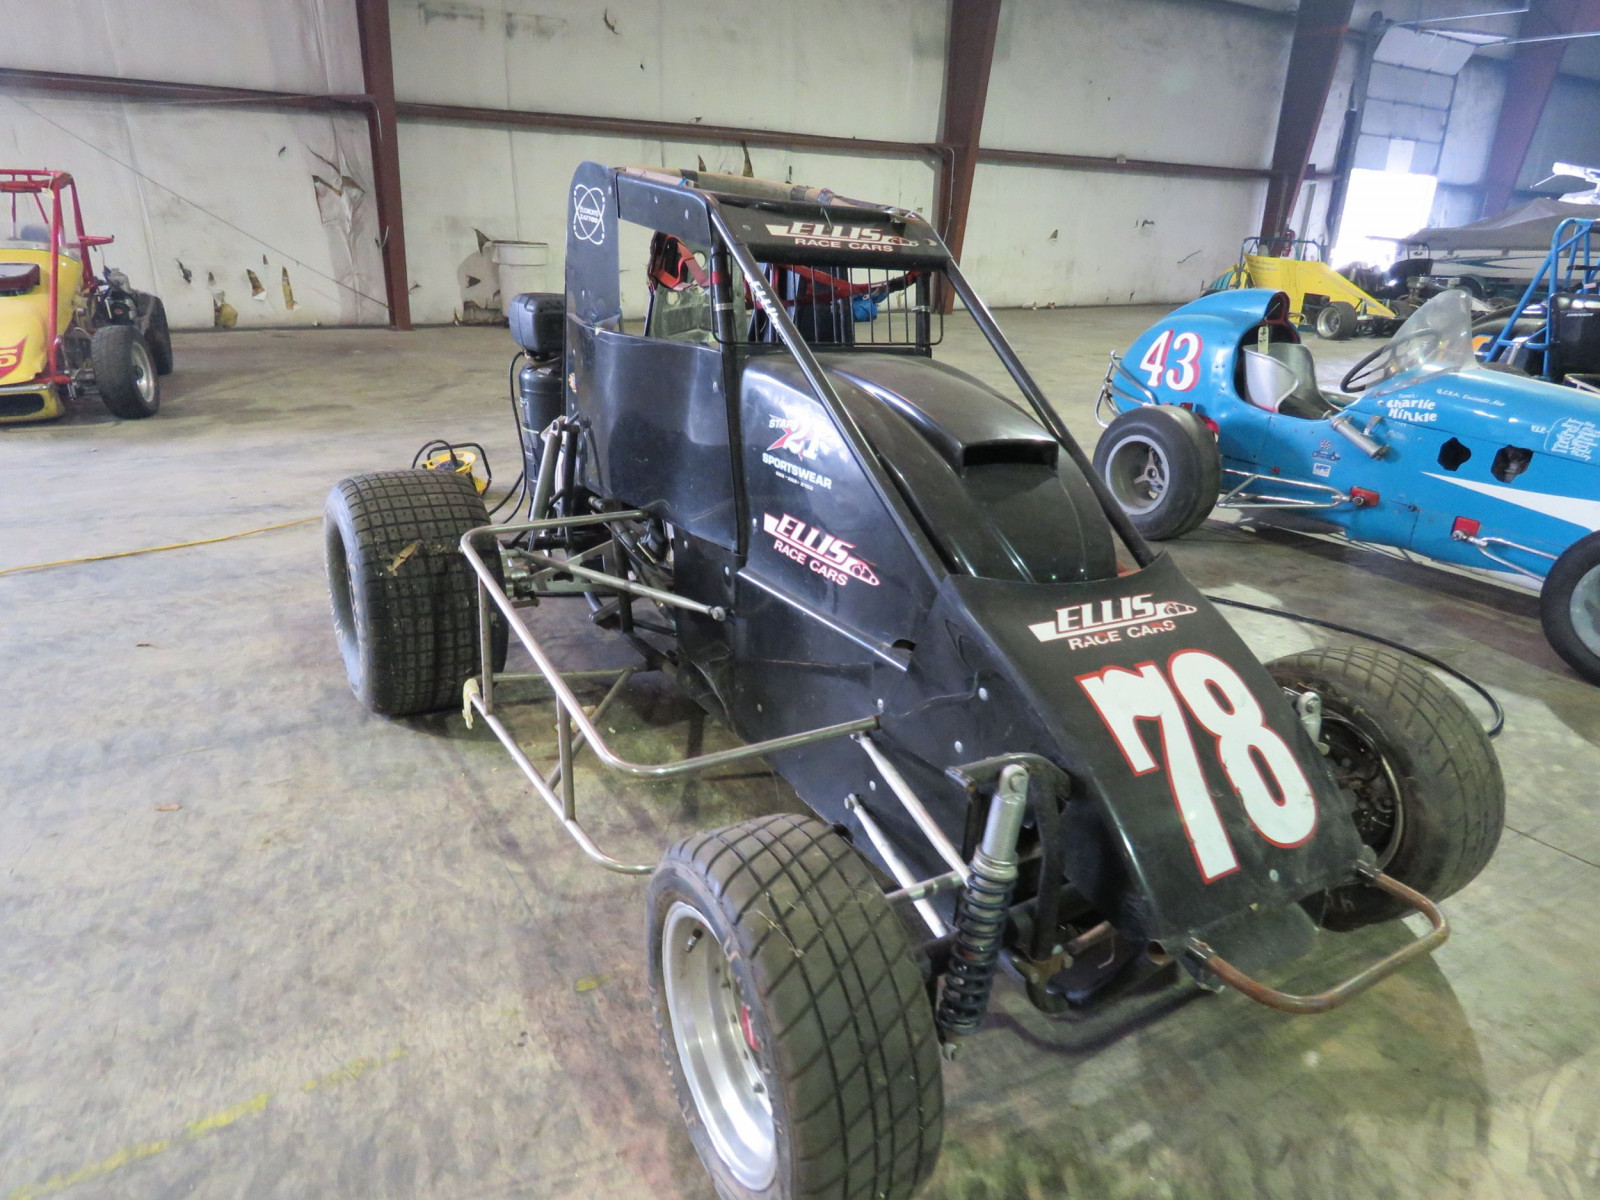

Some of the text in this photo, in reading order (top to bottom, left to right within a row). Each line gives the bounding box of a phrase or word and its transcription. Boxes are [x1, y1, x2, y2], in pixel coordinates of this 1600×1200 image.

[790, 221, 883, 242] ELLIS
[794, 238, 894, 253] RACE CARS
[1140, 329, 1204, 393] 43
[1386, 398, 1437, 411] Charlie
[1388, 408, 1438, 423] Hinkle
[762, 452, 832, 490] SPORTSWEAR
[775, 512, 857, 564] ELLIS
[773, 539, 849, 587] RACE CARS
[1055, 592, 1154, 633] ELLIS
[1067, 619, 1177, 651] RACE CARS
[1073, 648, 1320, 885] 78
